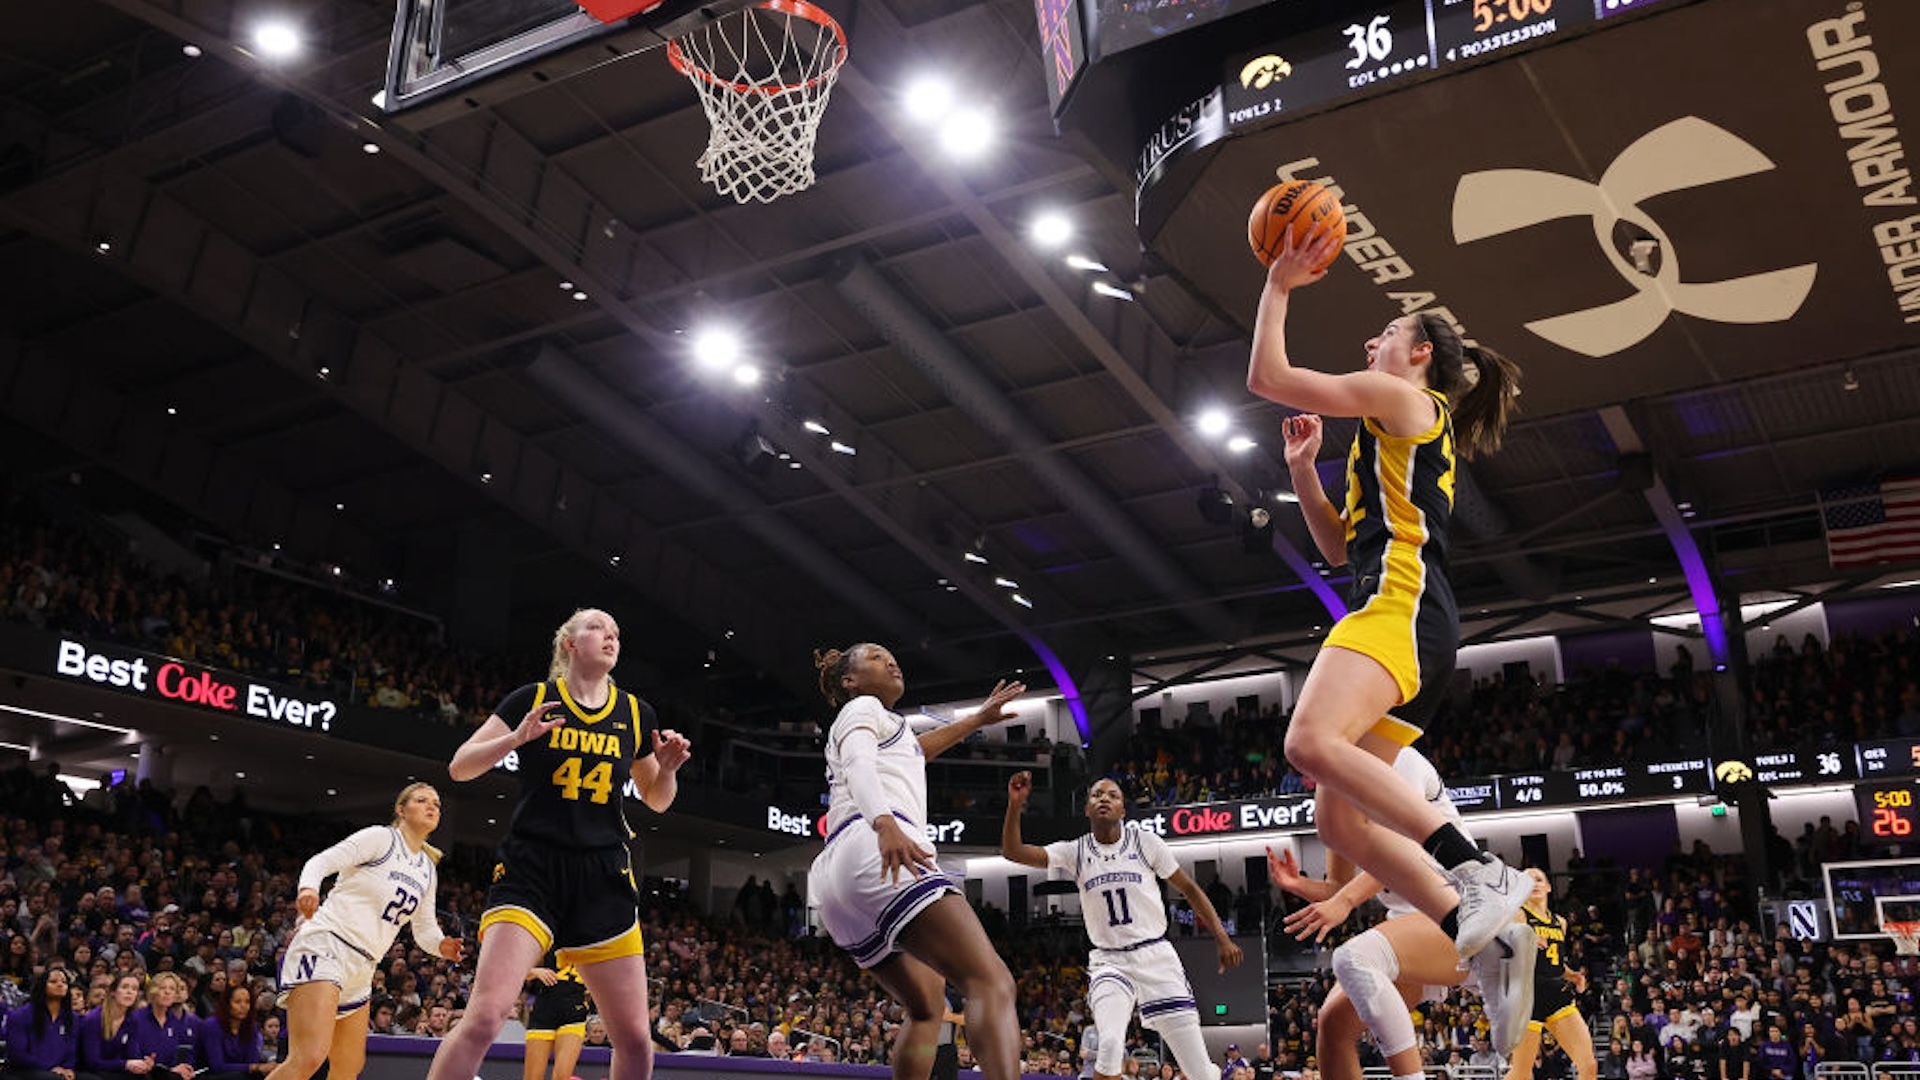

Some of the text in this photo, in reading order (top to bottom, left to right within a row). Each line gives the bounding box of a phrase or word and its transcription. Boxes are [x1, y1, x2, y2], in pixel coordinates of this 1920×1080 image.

[1341, 14, 1393, 69] 36
[1461, 19, 1557, 58] POSSESSION
[56, 639, 337, 731] Best Coke Ever?
[549, 726, 622, 759] IOWA
[1816, 752, 1842, 775] 36
[552, 757, 614, 805] 44
[1515, 788, 1543, 803] 4/8
[1578, 781, 1625, 797] 50.0%
[1672, 775, 1683, 789] 3
[1873, 790, 1912, 808] 5:00
[767, 806, 811, 836] Best
[924, 819, 965, 842] er?
[1125, 799, 1316, 835] est Coke Ever?
[1873, 808, 1912, 836] 26
[382, 886, 419, 925] 22
[1102, 887, 1133, 927] 11
[1546, 943, 1559, 966] 4
